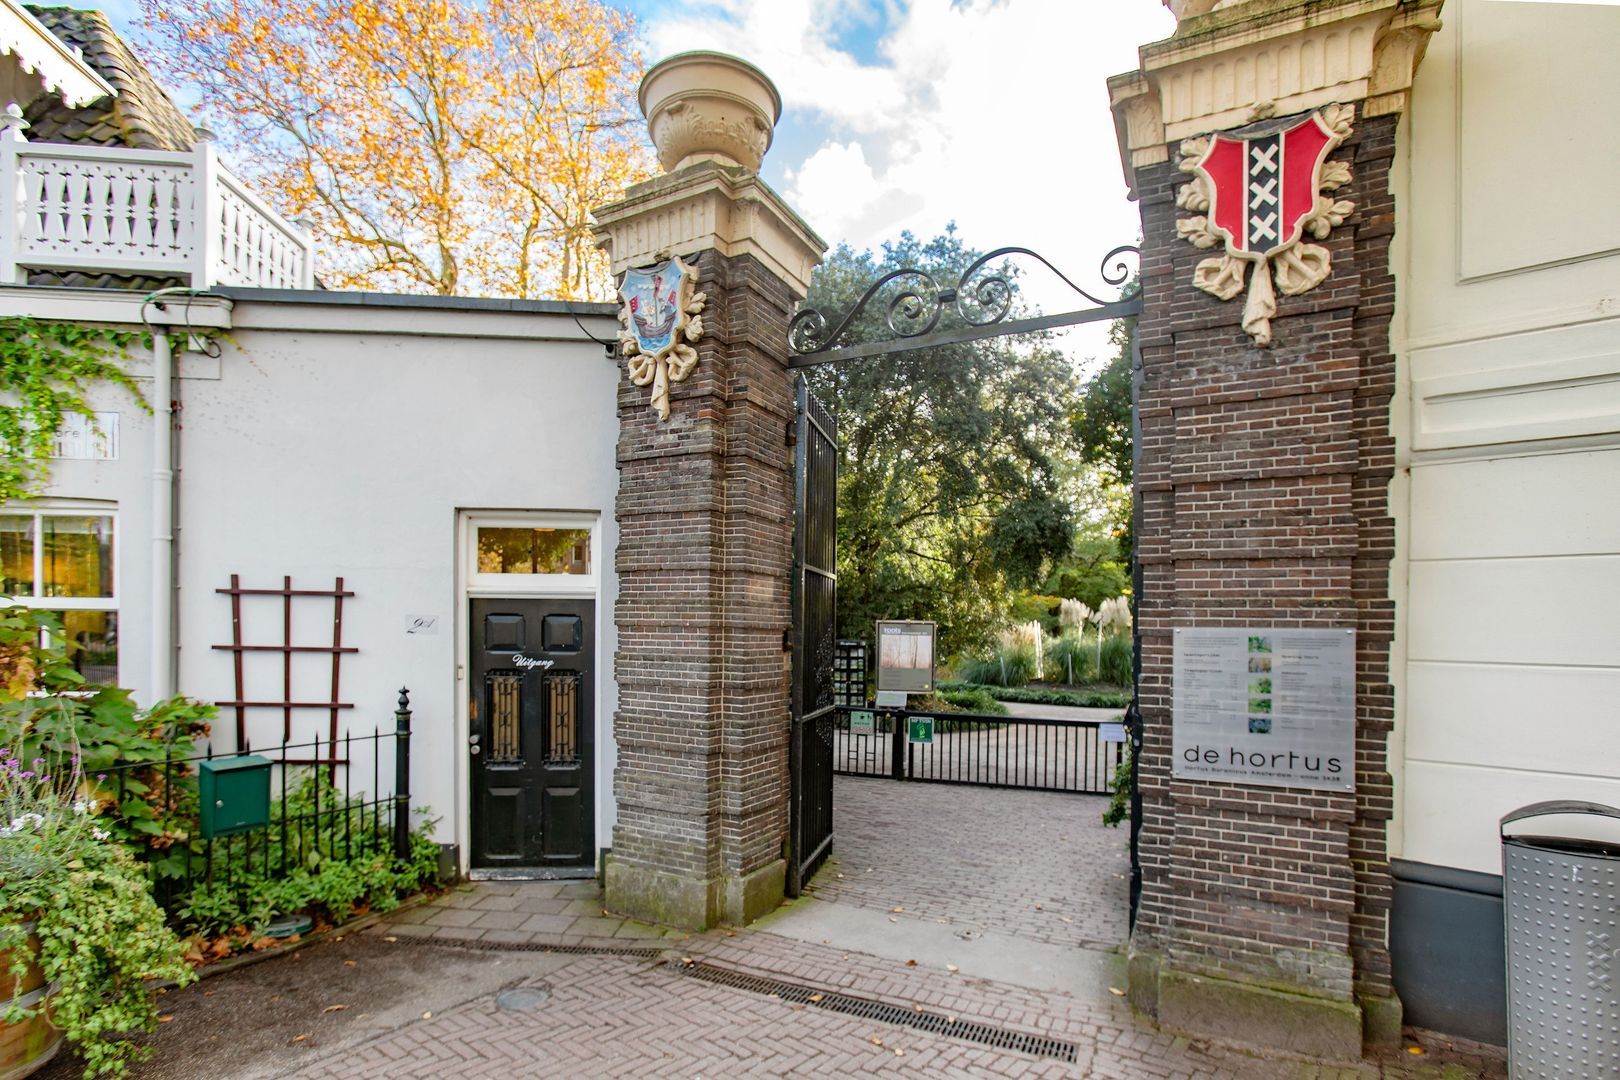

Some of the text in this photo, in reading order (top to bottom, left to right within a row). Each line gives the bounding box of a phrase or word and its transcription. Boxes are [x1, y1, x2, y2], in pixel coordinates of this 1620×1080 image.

[512, 654, 554, 670] Uitgang
[1184, 745, 1341, 772] de hortus
